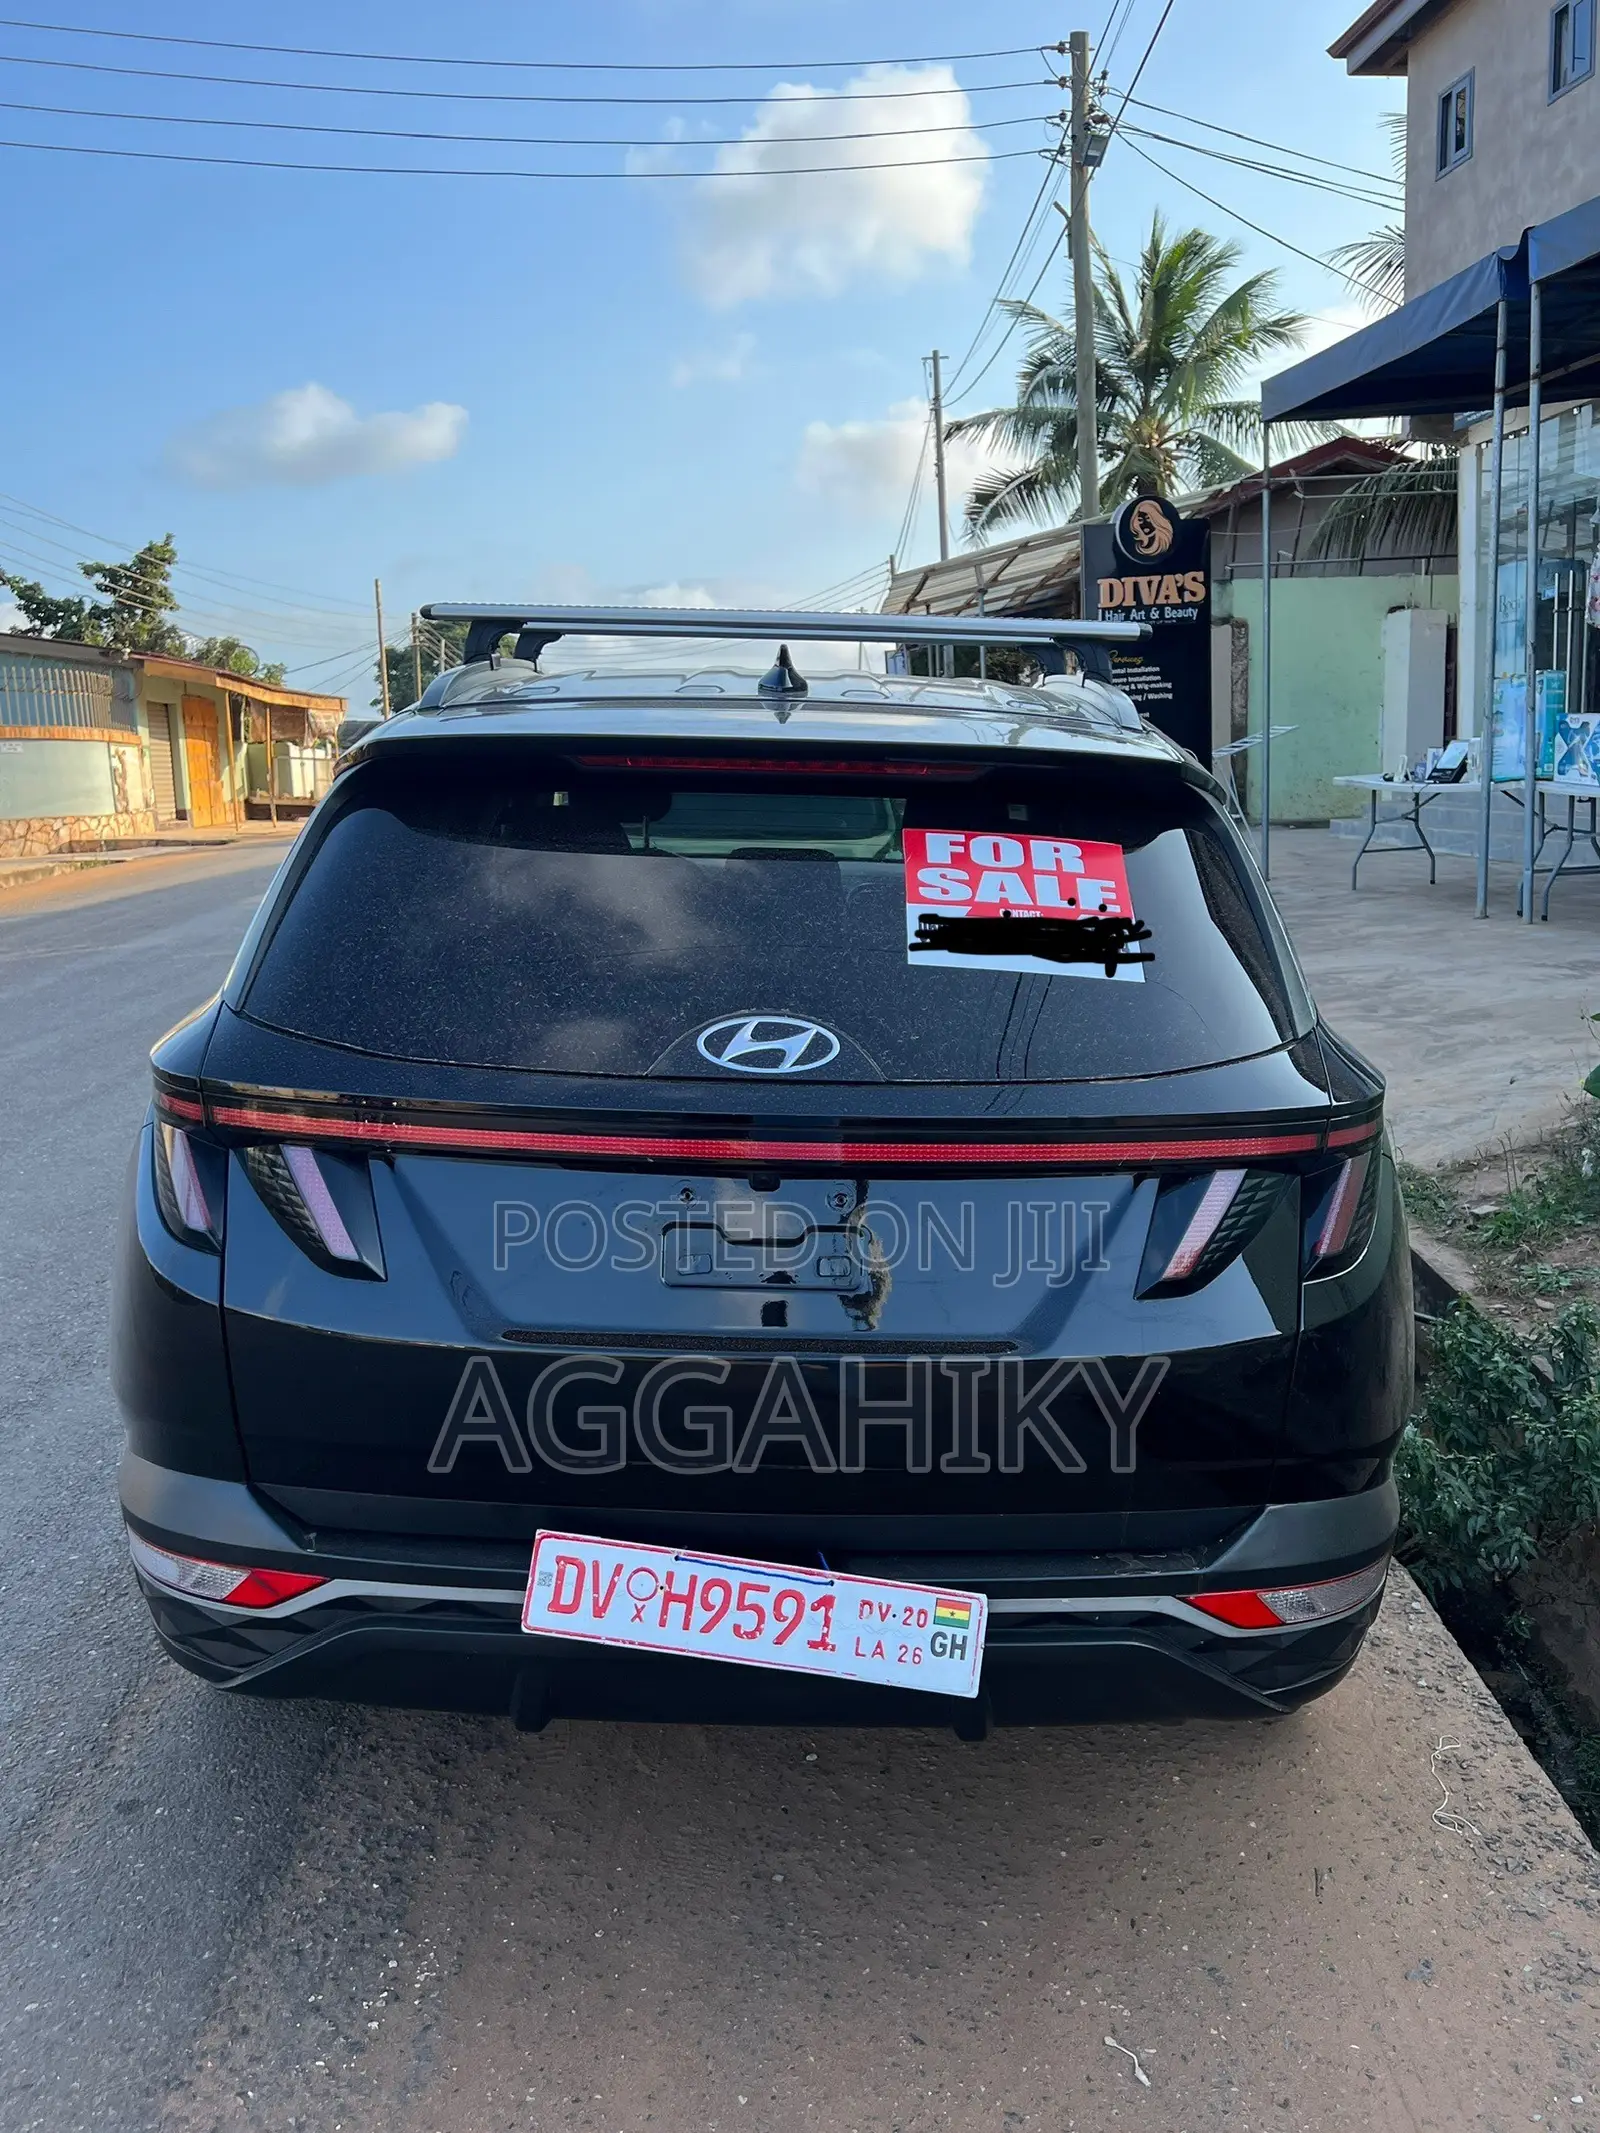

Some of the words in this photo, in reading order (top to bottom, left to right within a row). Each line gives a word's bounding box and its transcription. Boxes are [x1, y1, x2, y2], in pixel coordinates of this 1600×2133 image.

[1097, 571, 1206, 608] DIVA'S
[1105, 609, 1126, 622] Hair
[1130, 608, 1146, 620] Art
[1150, 607, 1160, 619] &
[1164, 606, 1198, 620] Beauty
[1127, 666, 1160, 674] Installation
[925, 832, 1085, 875] FOR
[916, 867, 1122, 912] SALE
[547, 1555, 624, 1619] DV
[658, 1570, 837, 1653] H9591
[930, 1631, 968, 1661] GH
